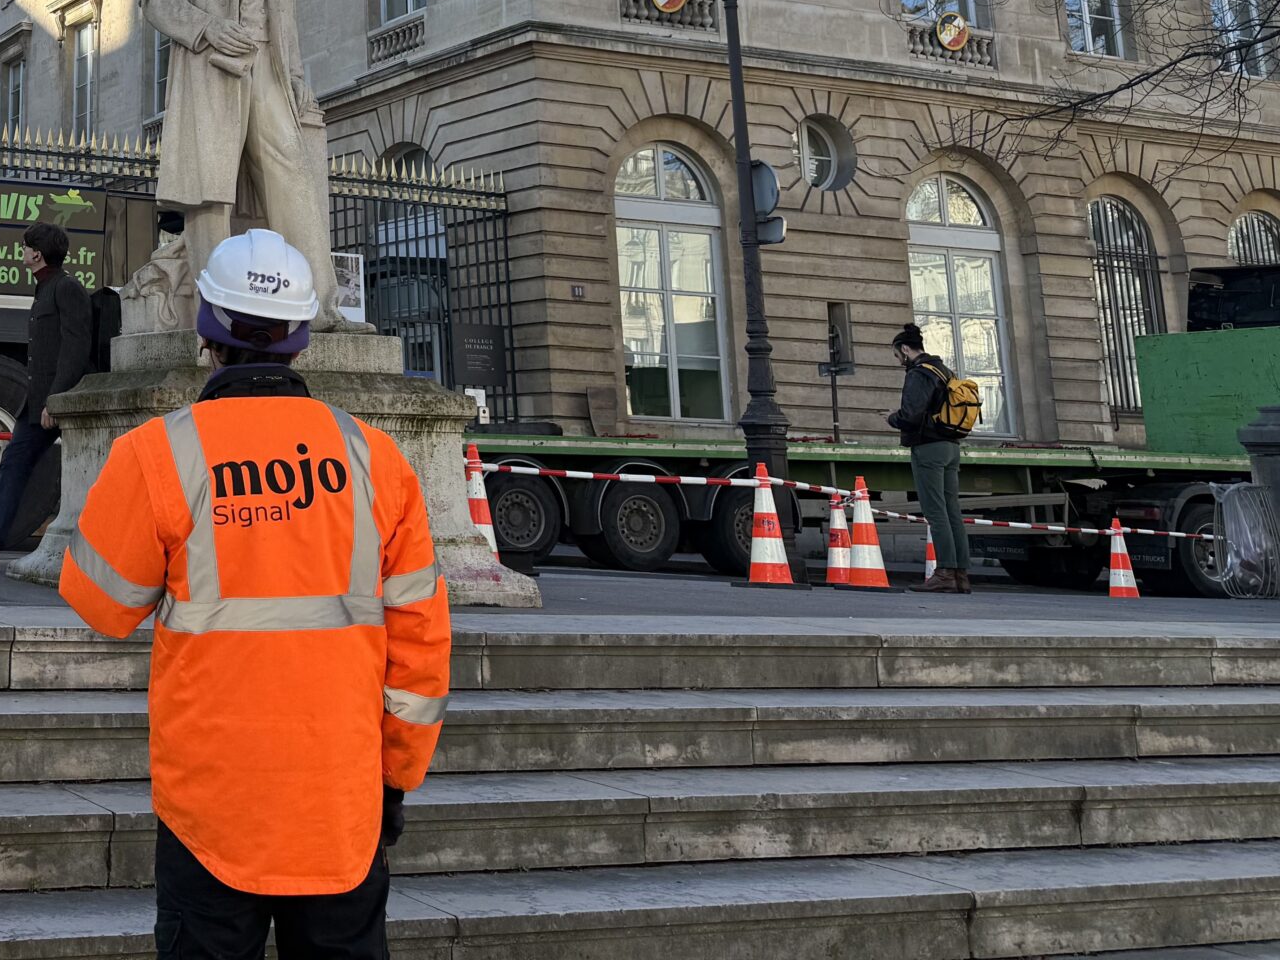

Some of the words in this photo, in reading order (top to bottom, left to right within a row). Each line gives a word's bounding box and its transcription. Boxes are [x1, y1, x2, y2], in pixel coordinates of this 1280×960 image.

[74, 270, 96, 289] 32
[247, 271, 290, 294] mojo
[249, 283, 269, 294] Signal
[211, 443, 347, 509] mojo
[213, 500, 291, 527] Signal
